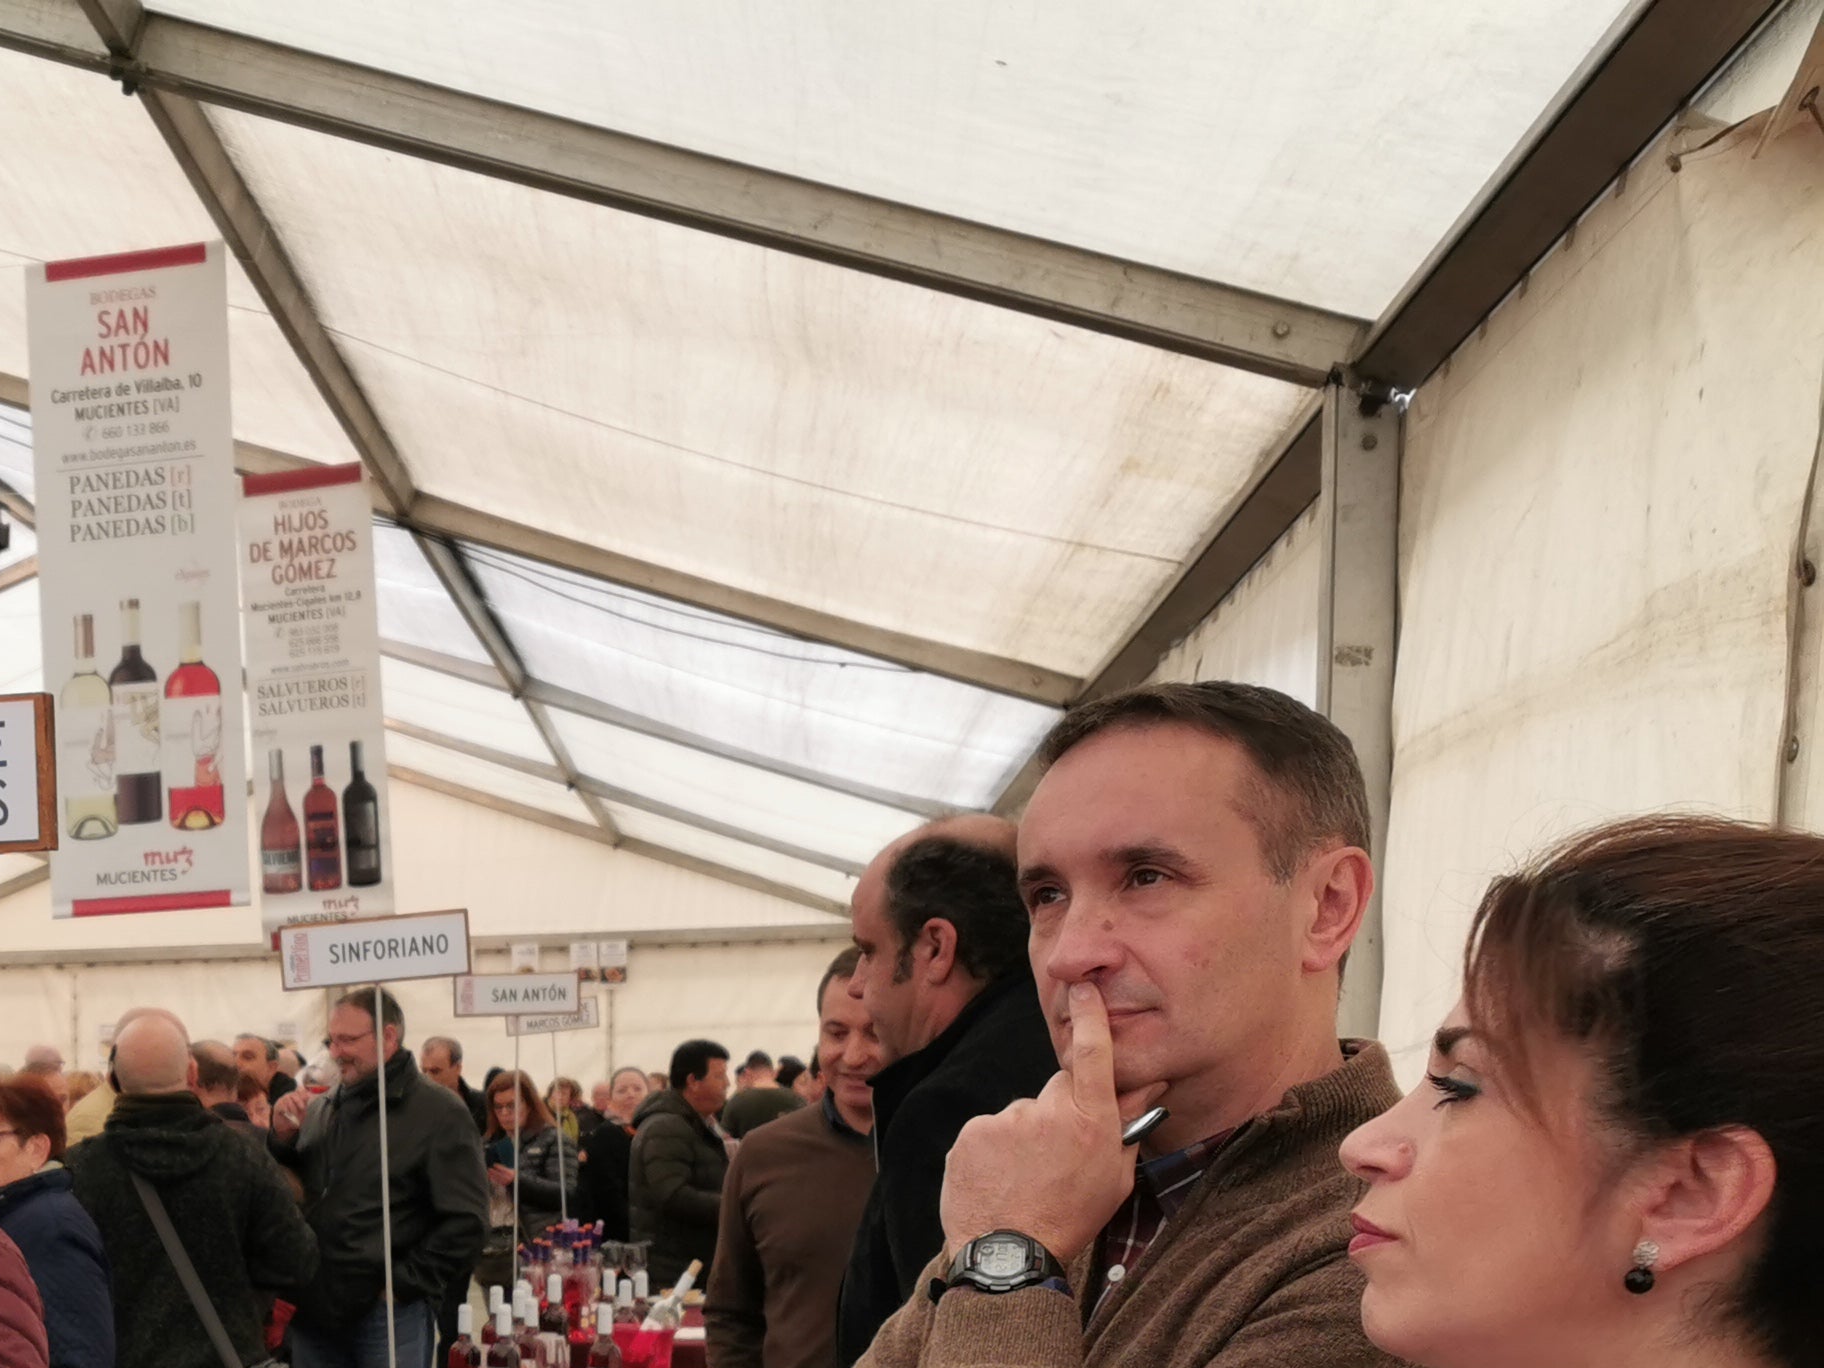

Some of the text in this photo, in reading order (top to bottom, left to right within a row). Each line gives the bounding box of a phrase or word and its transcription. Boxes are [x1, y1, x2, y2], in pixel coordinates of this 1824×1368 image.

[89, 286, 157, 305] BODEGAS
[97, 305, 150, 339] SAN
[80, 332, 171, 376] ANTÓN
[50, 385, 112, 404] Carretera
[115, 381, 131, 396] de
[188, 372, 202, 388] 10
[75, 396, 180, 421] MUCIENTES [VA]
[69, 465, 191, 495] PANEDAS [r]
[71, 488, 192, 519] PANEDAS [t]
[69, 513, 194, 543] PANEDAS [b]
[274, 509, 328, 536] HIJOS
[249, 530, 357, 563] DE MARCOS
[271, 557, 337, 585] GÓMEZ
[267, 608, 323, 624] MUCIENTES
[257, 677, 348, 700] SALVUEROS
[258, 694, 349, 716] SALVUEROS
[96, 869, 178, 886] MUCIENTES
[286, 911, 347, 924] MUCIENTES
[329, 934, 449, 965] SINFORIANO
[491, 988, 517, 1003] SAN
[523, 984, 567, 1001] ANTÓN
